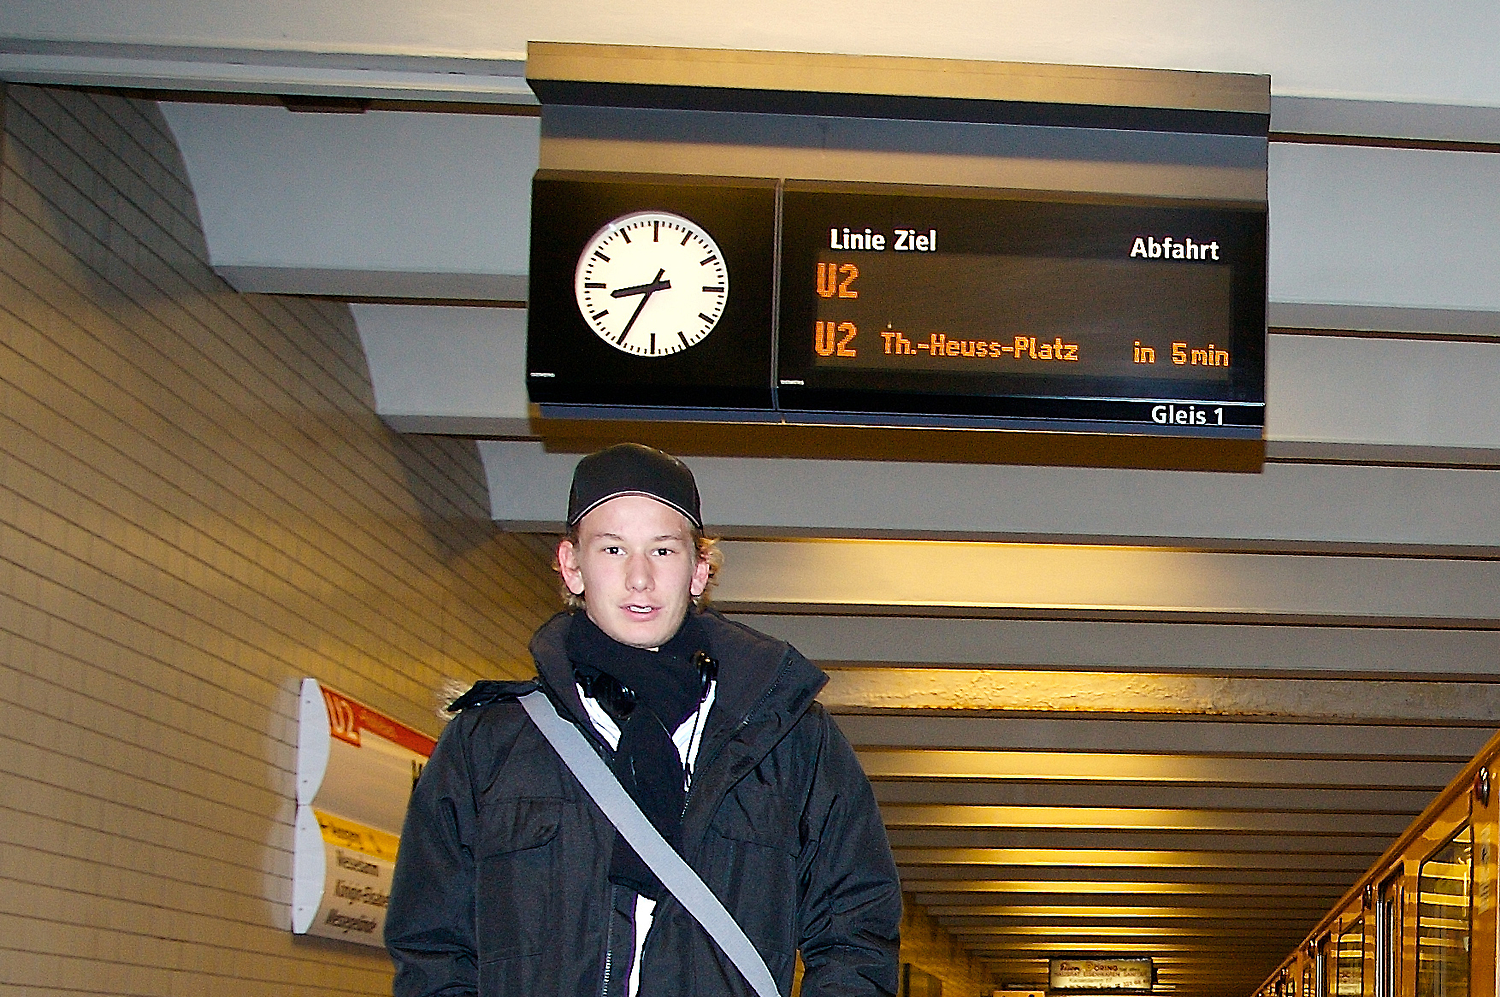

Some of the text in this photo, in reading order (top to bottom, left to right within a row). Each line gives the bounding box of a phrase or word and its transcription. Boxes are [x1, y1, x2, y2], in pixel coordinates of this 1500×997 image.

[830, 228, 936, 251] Linie Ziel
[1130, 236, 1219, 260] Abfahrt
[816, 262, 859, 298] U2
[814, 321, 857, 357] U2
[881, 331, 1079, 360] Th.-Heuss-Platz
[1133, 341, 1155, 363] in
[1151, 405, 1223, 425] Gleis 1
